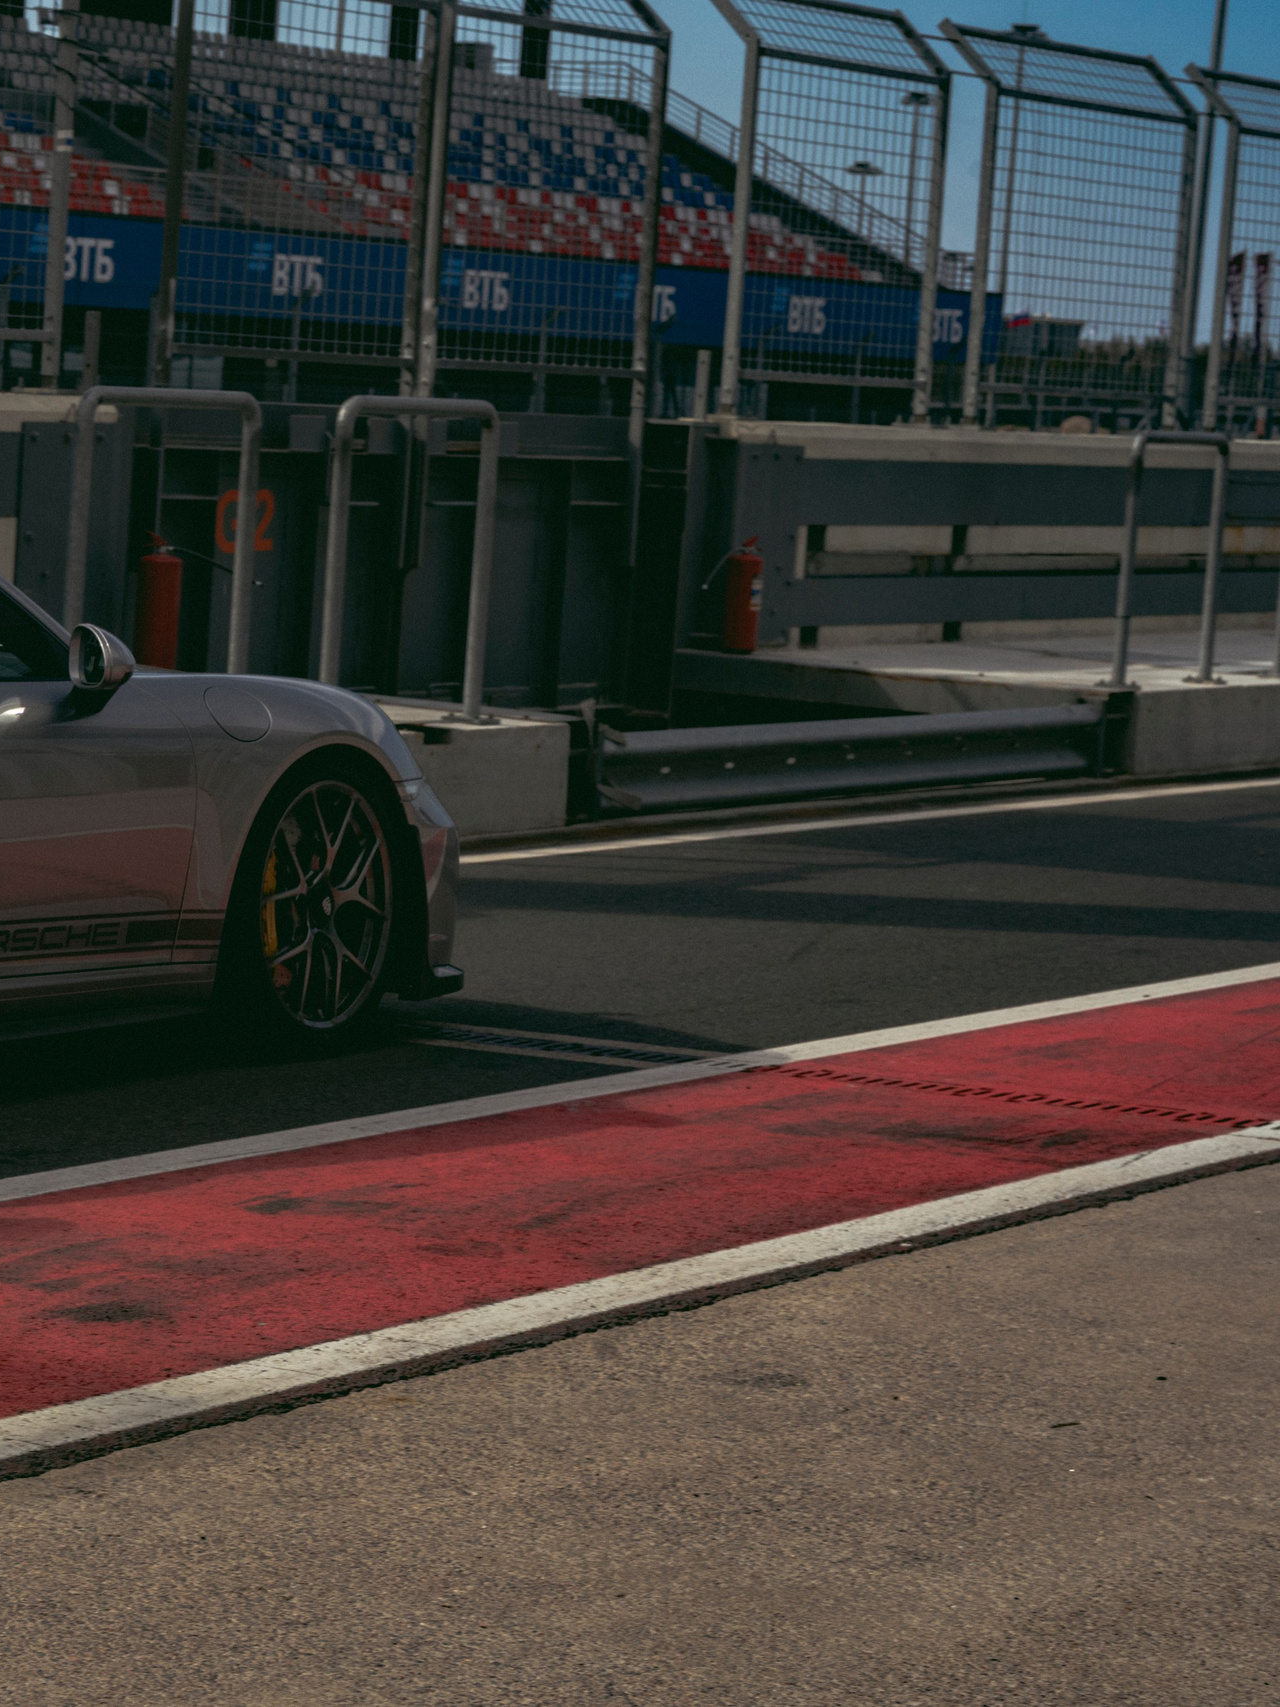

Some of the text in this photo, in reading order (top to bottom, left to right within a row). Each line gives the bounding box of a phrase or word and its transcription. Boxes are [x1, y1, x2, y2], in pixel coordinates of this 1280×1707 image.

[63, 235, 116, 284] ВТБ
[272, 253, 324, 298] ВТБ
[463, 268, 510, 312] ВТБ
[648, 284, 677, 323] ТБ
[787, 294, 828, 336] ВТБ
